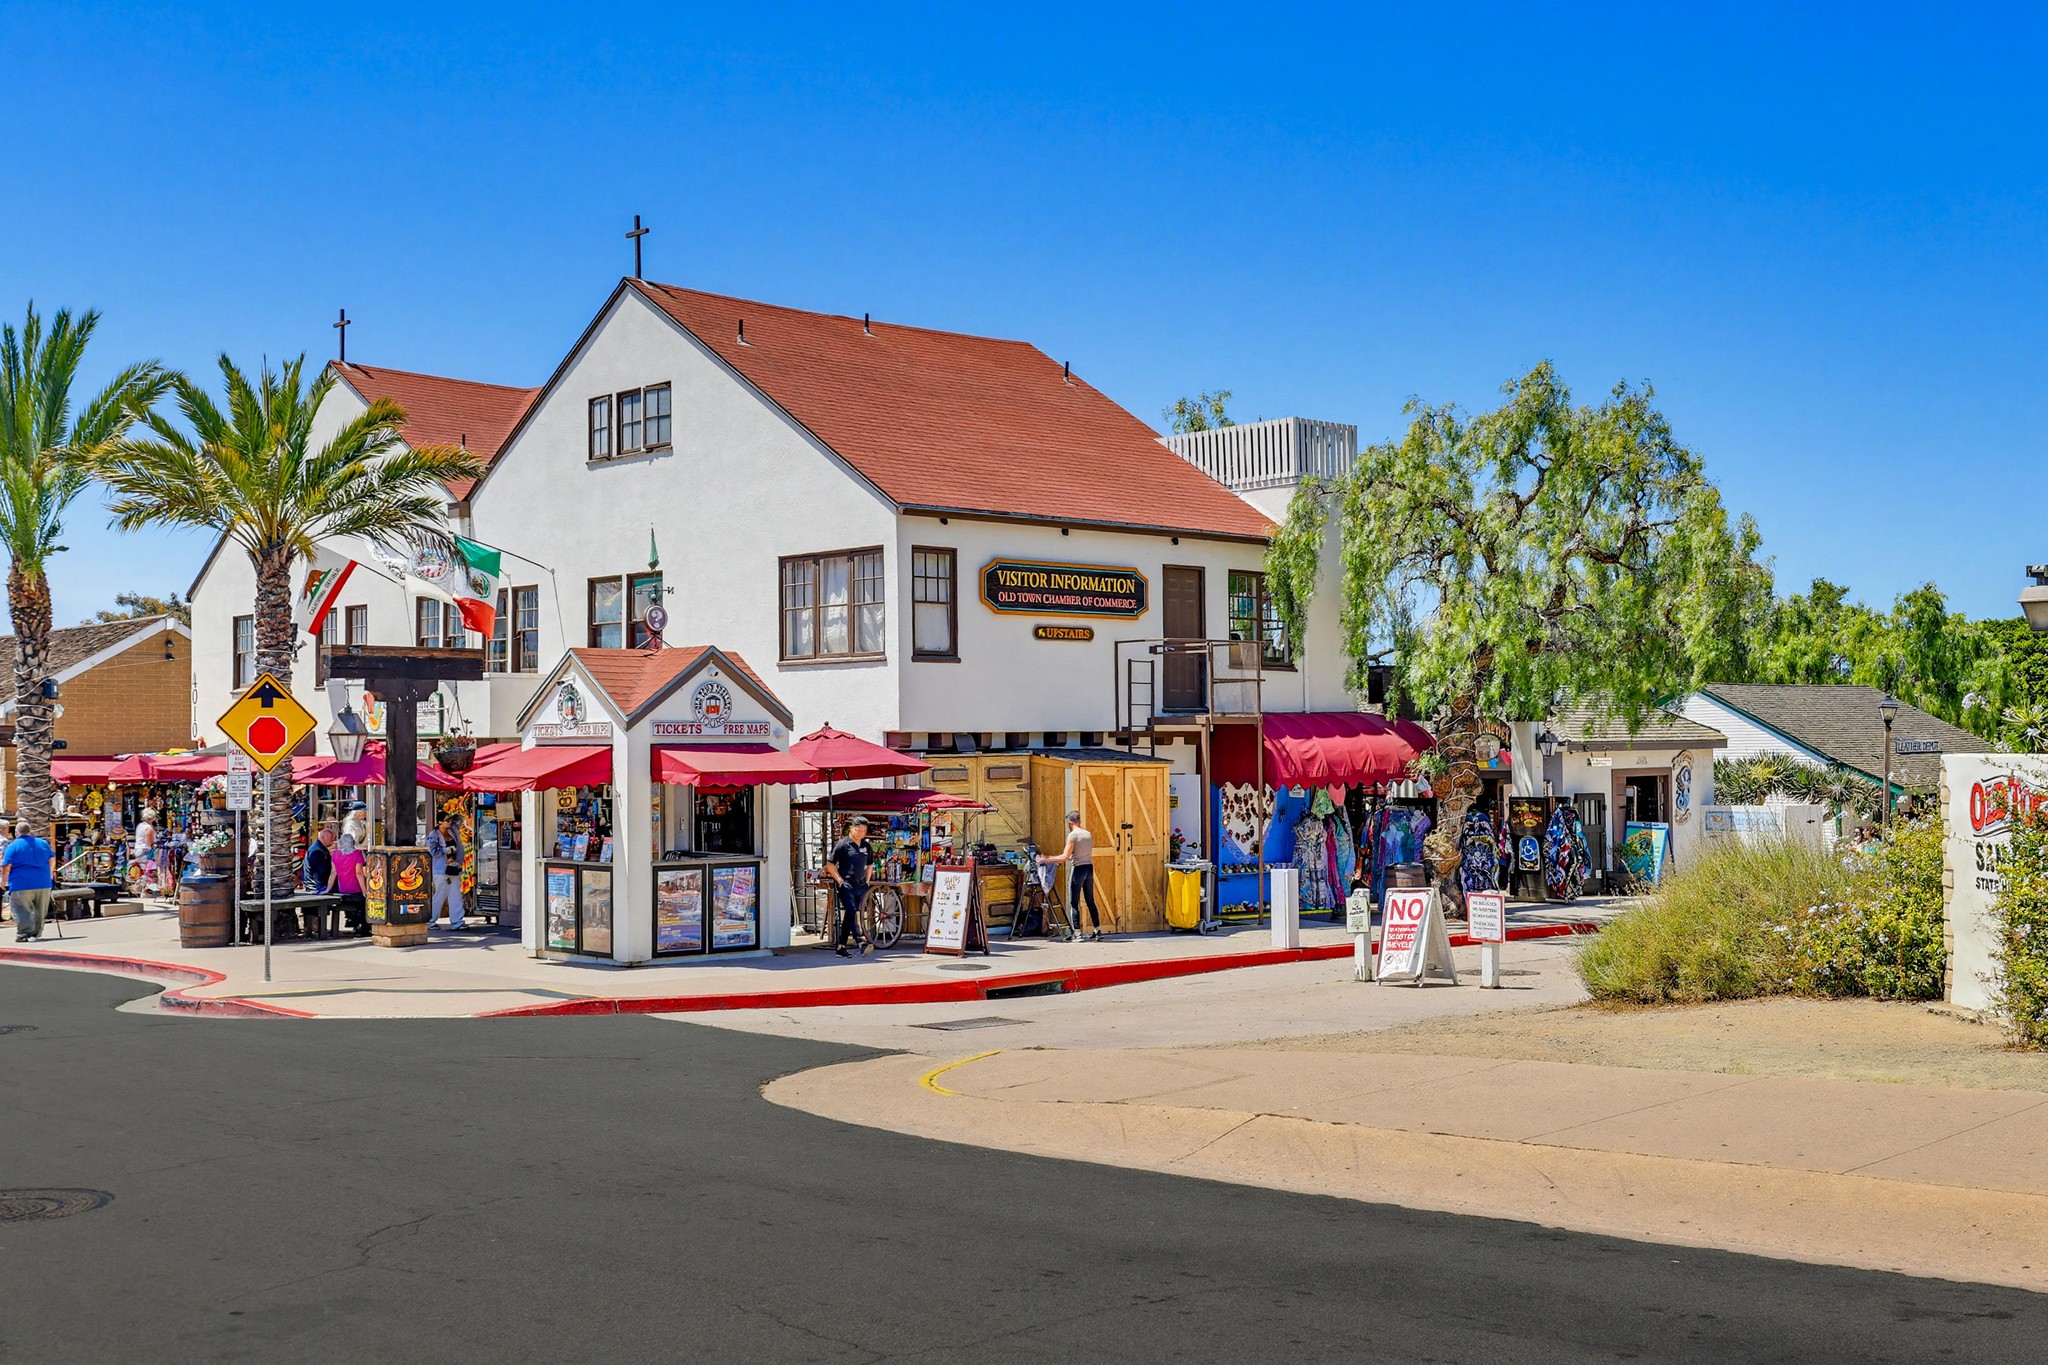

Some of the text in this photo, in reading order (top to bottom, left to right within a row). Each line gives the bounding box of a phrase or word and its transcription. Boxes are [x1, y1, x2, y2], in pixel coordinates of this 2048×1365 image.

[997, 570, 1136, 594] VISITOR INFORMATION
[998, 591, 1138, 609] OLD TOWN CHAMBER OF COMMERCE
[1046, 627, 1090, 639] UPSTAIRS
[655, 723, 769, 735] TICKETS FREE MAPS
[1389, 898, 1424, 921] NO
